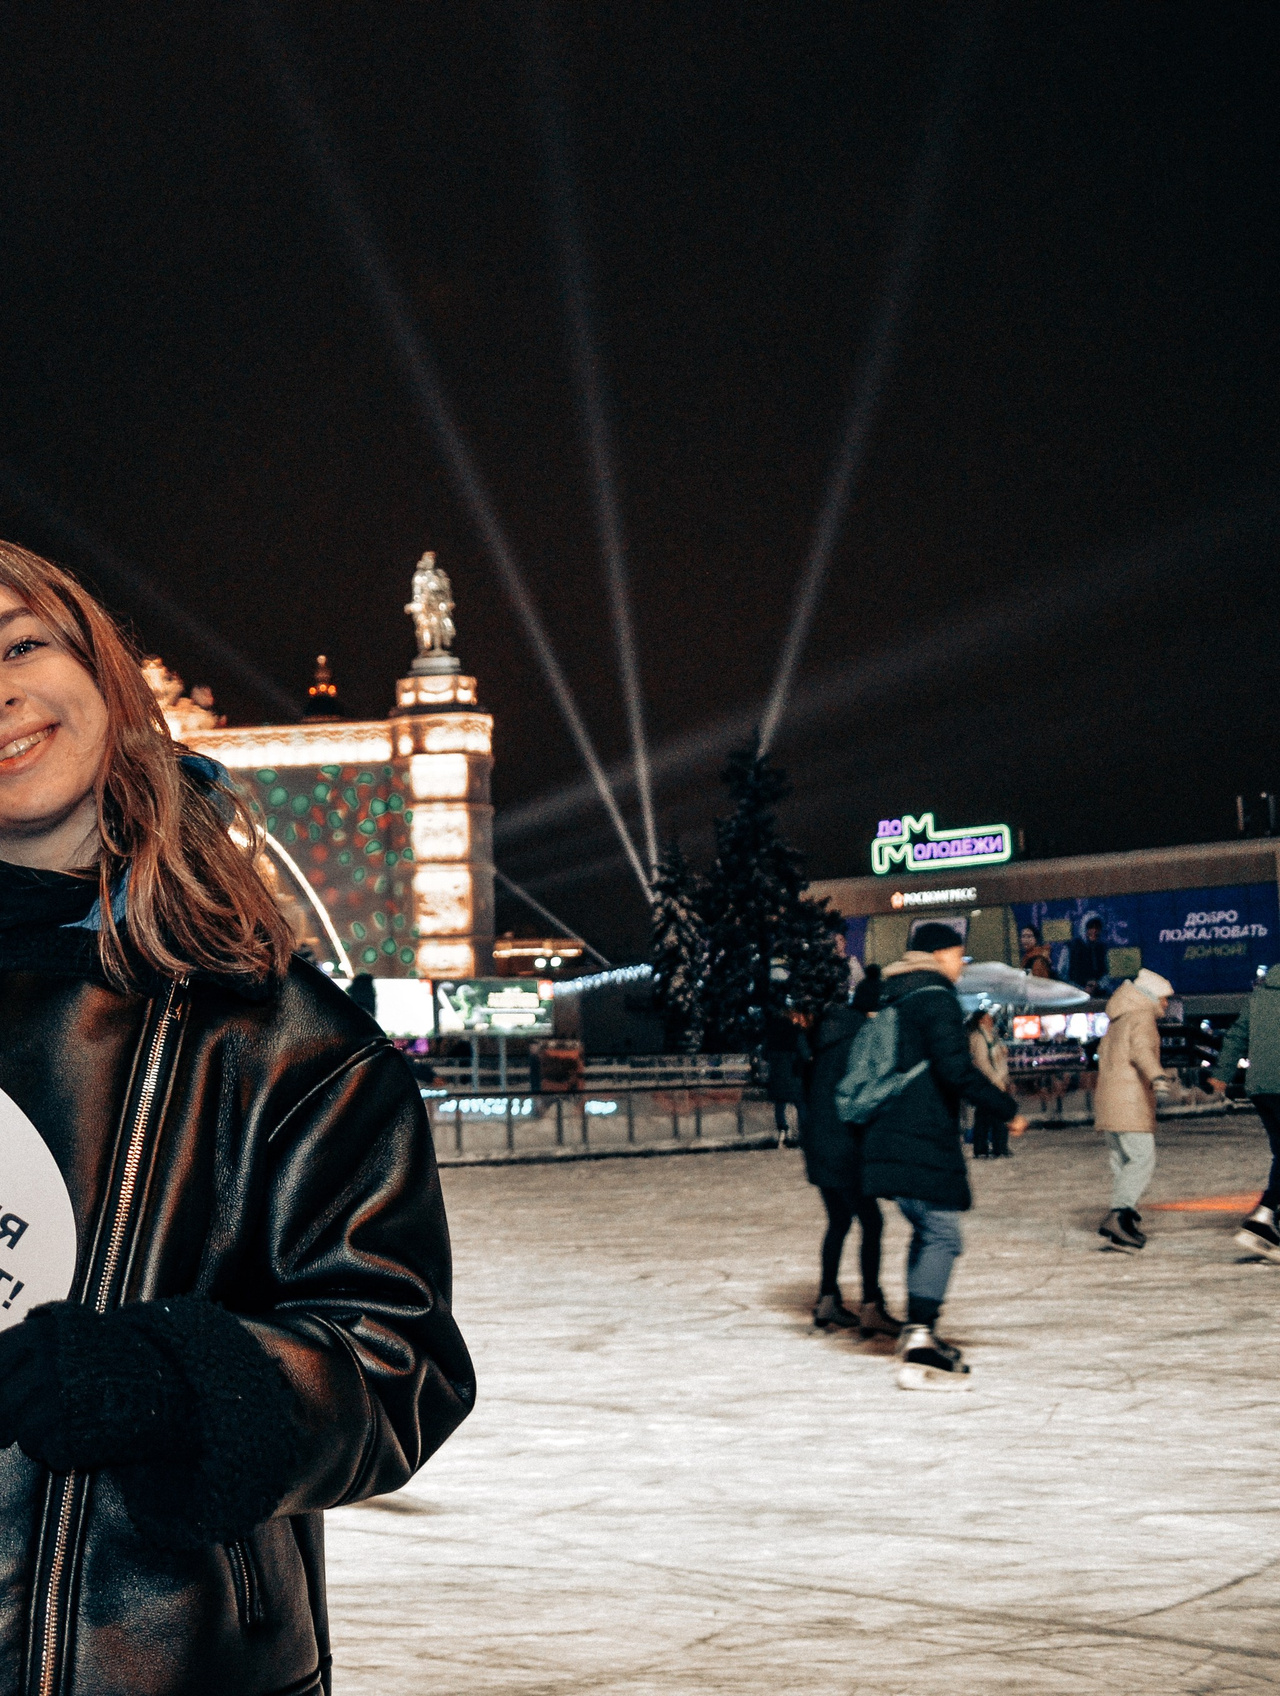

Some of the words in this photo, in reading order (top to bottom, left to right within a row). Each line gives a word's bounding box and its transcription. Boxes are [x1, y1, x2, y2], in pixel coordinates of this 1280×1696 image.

[877, 812, 934, 840] ДОМ
[1184, 909, 1238, 927] ДОБРО
[1159, 923, 1268, 942] ПОЖАЛОВАТЬ
